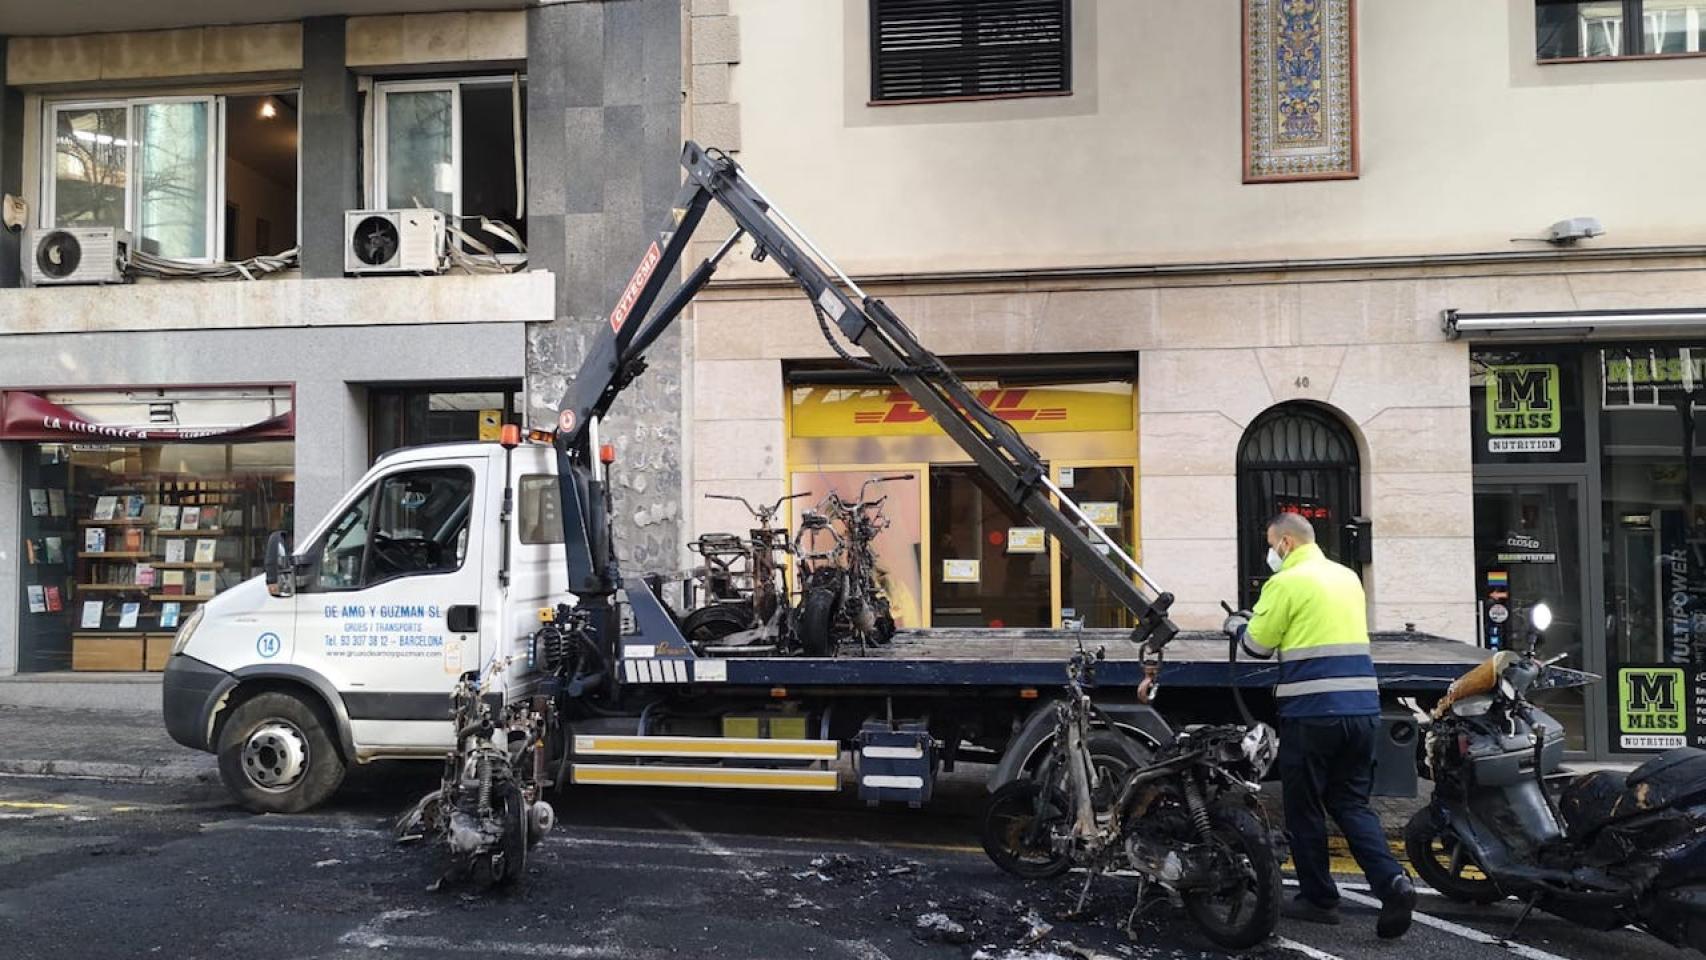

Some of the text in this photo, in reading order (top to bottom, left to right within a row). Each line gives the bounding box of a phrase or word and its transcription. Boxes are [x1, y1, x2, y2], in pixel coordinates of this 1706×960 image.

[1294, 376, 1310, 388] 40
[1495, 414, 1552, 429] MASS
[1493, 440, 1557, 450] NUTRITION
[324, 605, 338, 618] DE
[341, 605, 366, 618] AMO
[369, 605, 377, 618] Y
[380, 605, 425, 618] GUZMAN
[375, 622, 423, 633] TRANSPORTS
[399, 635, 444, 647] BARCELONA
[1626, 672, 1679, 712] M
[1627, 714, 1679, 728] MASS
[1624, 738, 1683, 747] NUTRITION
